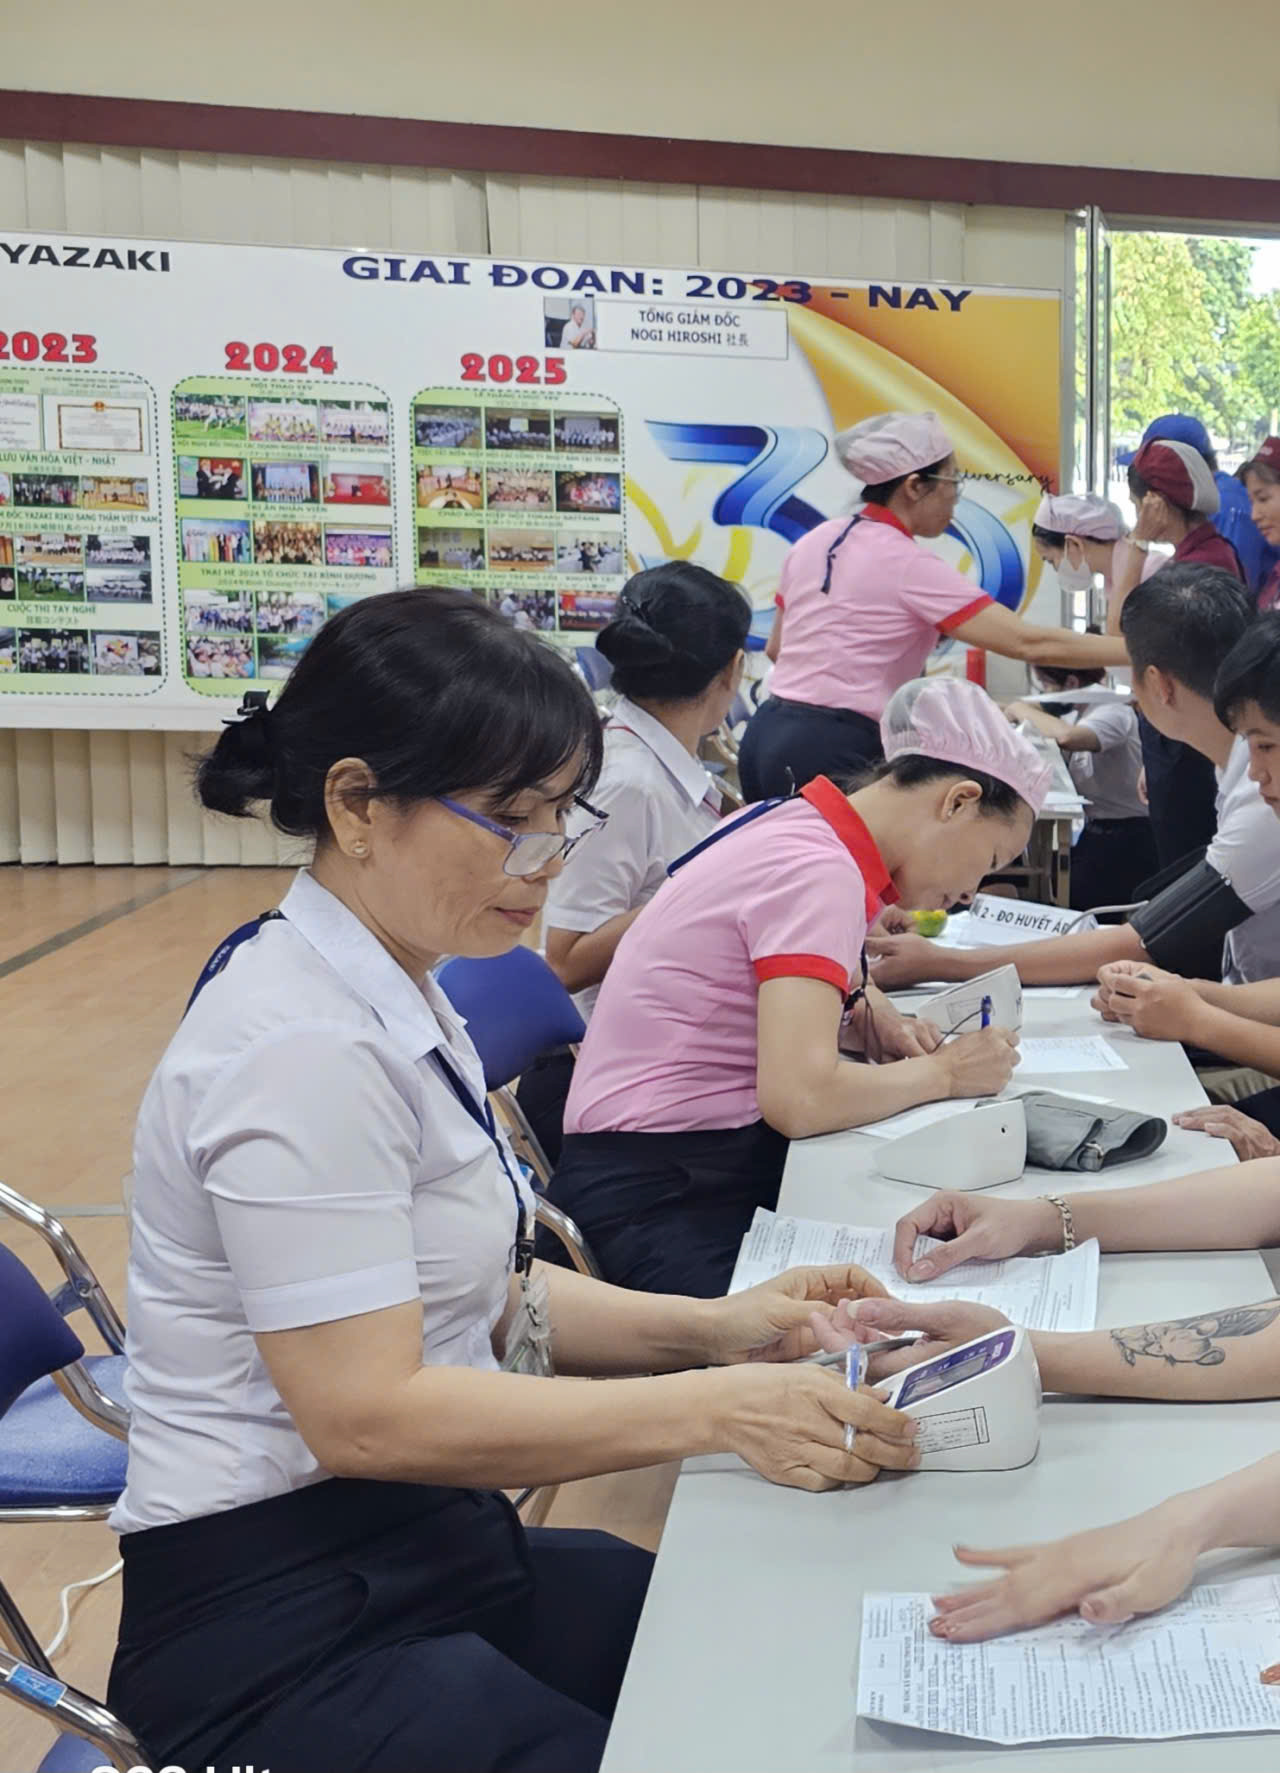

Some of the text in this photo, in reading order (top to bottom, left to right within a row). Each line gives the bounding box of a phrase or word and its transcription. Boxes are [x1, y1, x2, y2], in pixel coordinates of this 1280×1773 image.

[0, 242, 170, 272] YAZAKI
[342, 256, 471, 286] GIAI
[488, 264, 663, 298] ĐOẠN:
[686, 274, 813, 304] 2023
[868, 284, 973, 313] NAY
[639, 306, 741, 328] TỔNG GIÁM ĐỐC
[631, 328, 722, 345] NOGI HIROSHI
[224, 341, 338, 375] 2024
[460, 353, 568, 386] 2025
[981, 906, 989, 919] 2
[997, 909, 1014, 923] ĐO
[1015, 912, 1053, 931] HUYẾT
